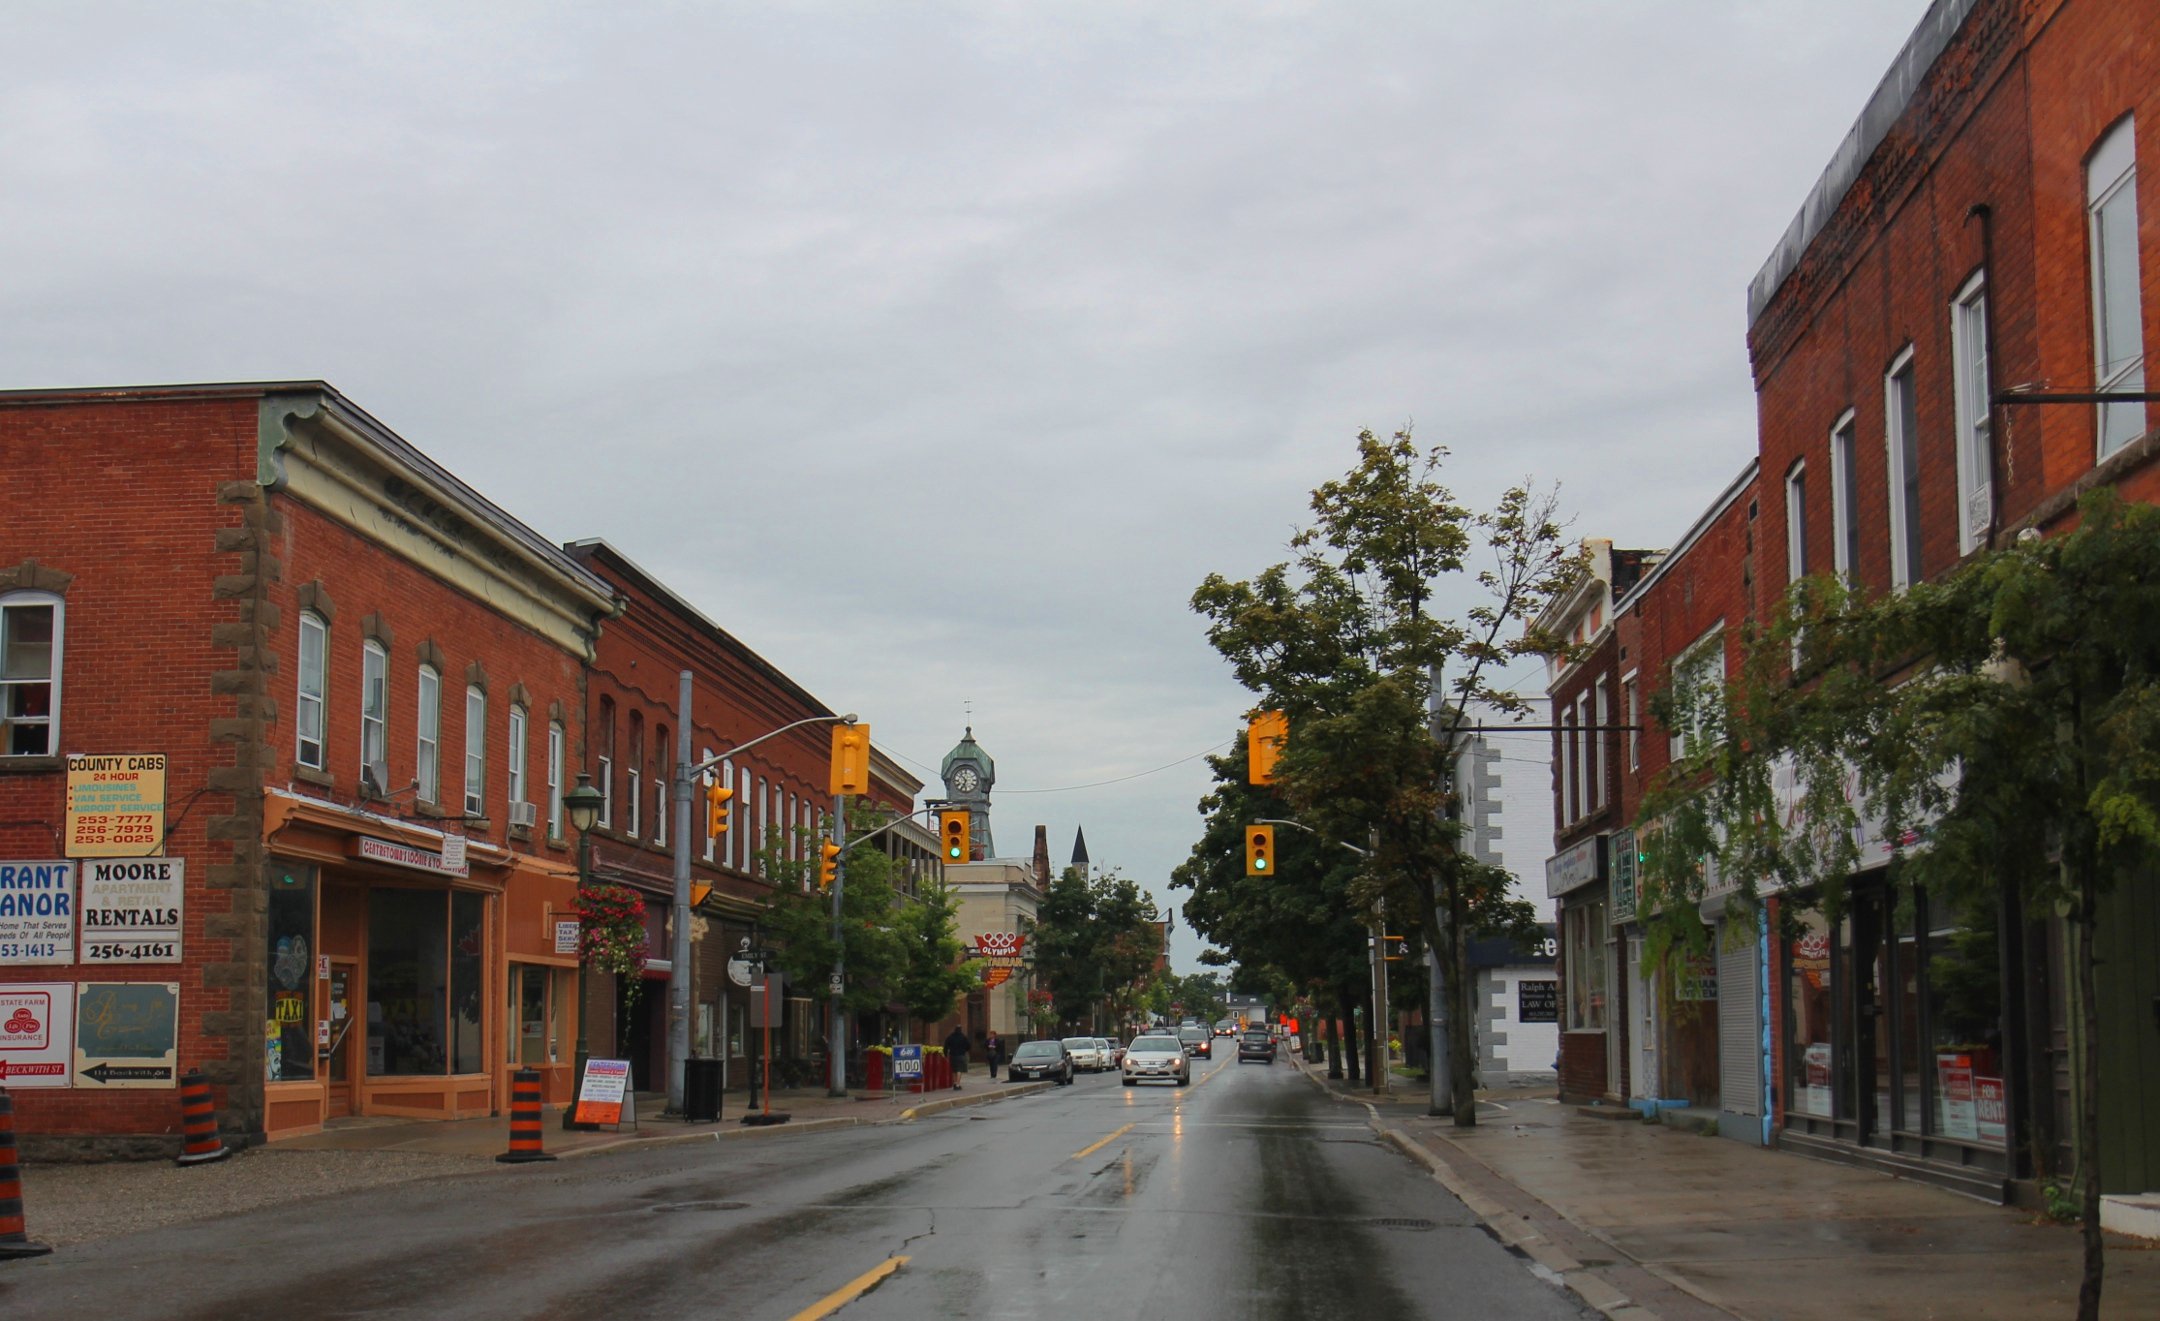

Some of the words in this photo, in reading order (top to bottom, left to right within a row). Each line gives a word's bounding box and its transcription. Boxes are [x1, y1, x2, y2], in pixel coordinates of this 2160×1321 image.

[69, 758, 122, 771] COUNTY
[128, 757, 164, 771] CABS
[94, 773, 106, 781] 24
[110, 773, 139, 781] HOUR
[74, 784, 136, 792] LIMOUSINES
[75, 794, 96, 802] VAN
[100, 794, 142, 802] SERVICE
[74, 804, 116, 812] AIRPORT
[120, 804, 163, 812] SERVICE
[78, 815, 152, 824] 253-7777
[77, 825, 153, 834] 256-7979
[75, 835, 154, 844] 253-0025
[1, 865, 69, 889] RANT
[95, 864, 171, 881] MOORE
[92, 884, 173, 894] APARTMENT
[0, 893, 70, 916] ANOR
[101, 897, 109, 907] &
[118, 896, 163, 906] RETAIL
[86, 909, 178, 926] RENTALS
[23, 921, 39, 929] That
[42, 921, 67, 929] Serves
[20, 931, 29, 939] Of
[34, 931, 43, 939] All
[46, 930, 70, 941] People
[90, 944, 174, 959] 256-4161
[982, 946, 1017, 956] OLYMPIA
[1521, 983, 1544, 992] Ralph
[1522, 1000, 1542, 1008] LAW
[277, 1000, 303, 1020] TAXI
[6, 1066, 51, 1074] BECKWITH
[898, 1061, 919, 1071] 100
[1982, 1085, 1995, 1098] FOR
[1978, 1099, 2002, 1121] RENT
